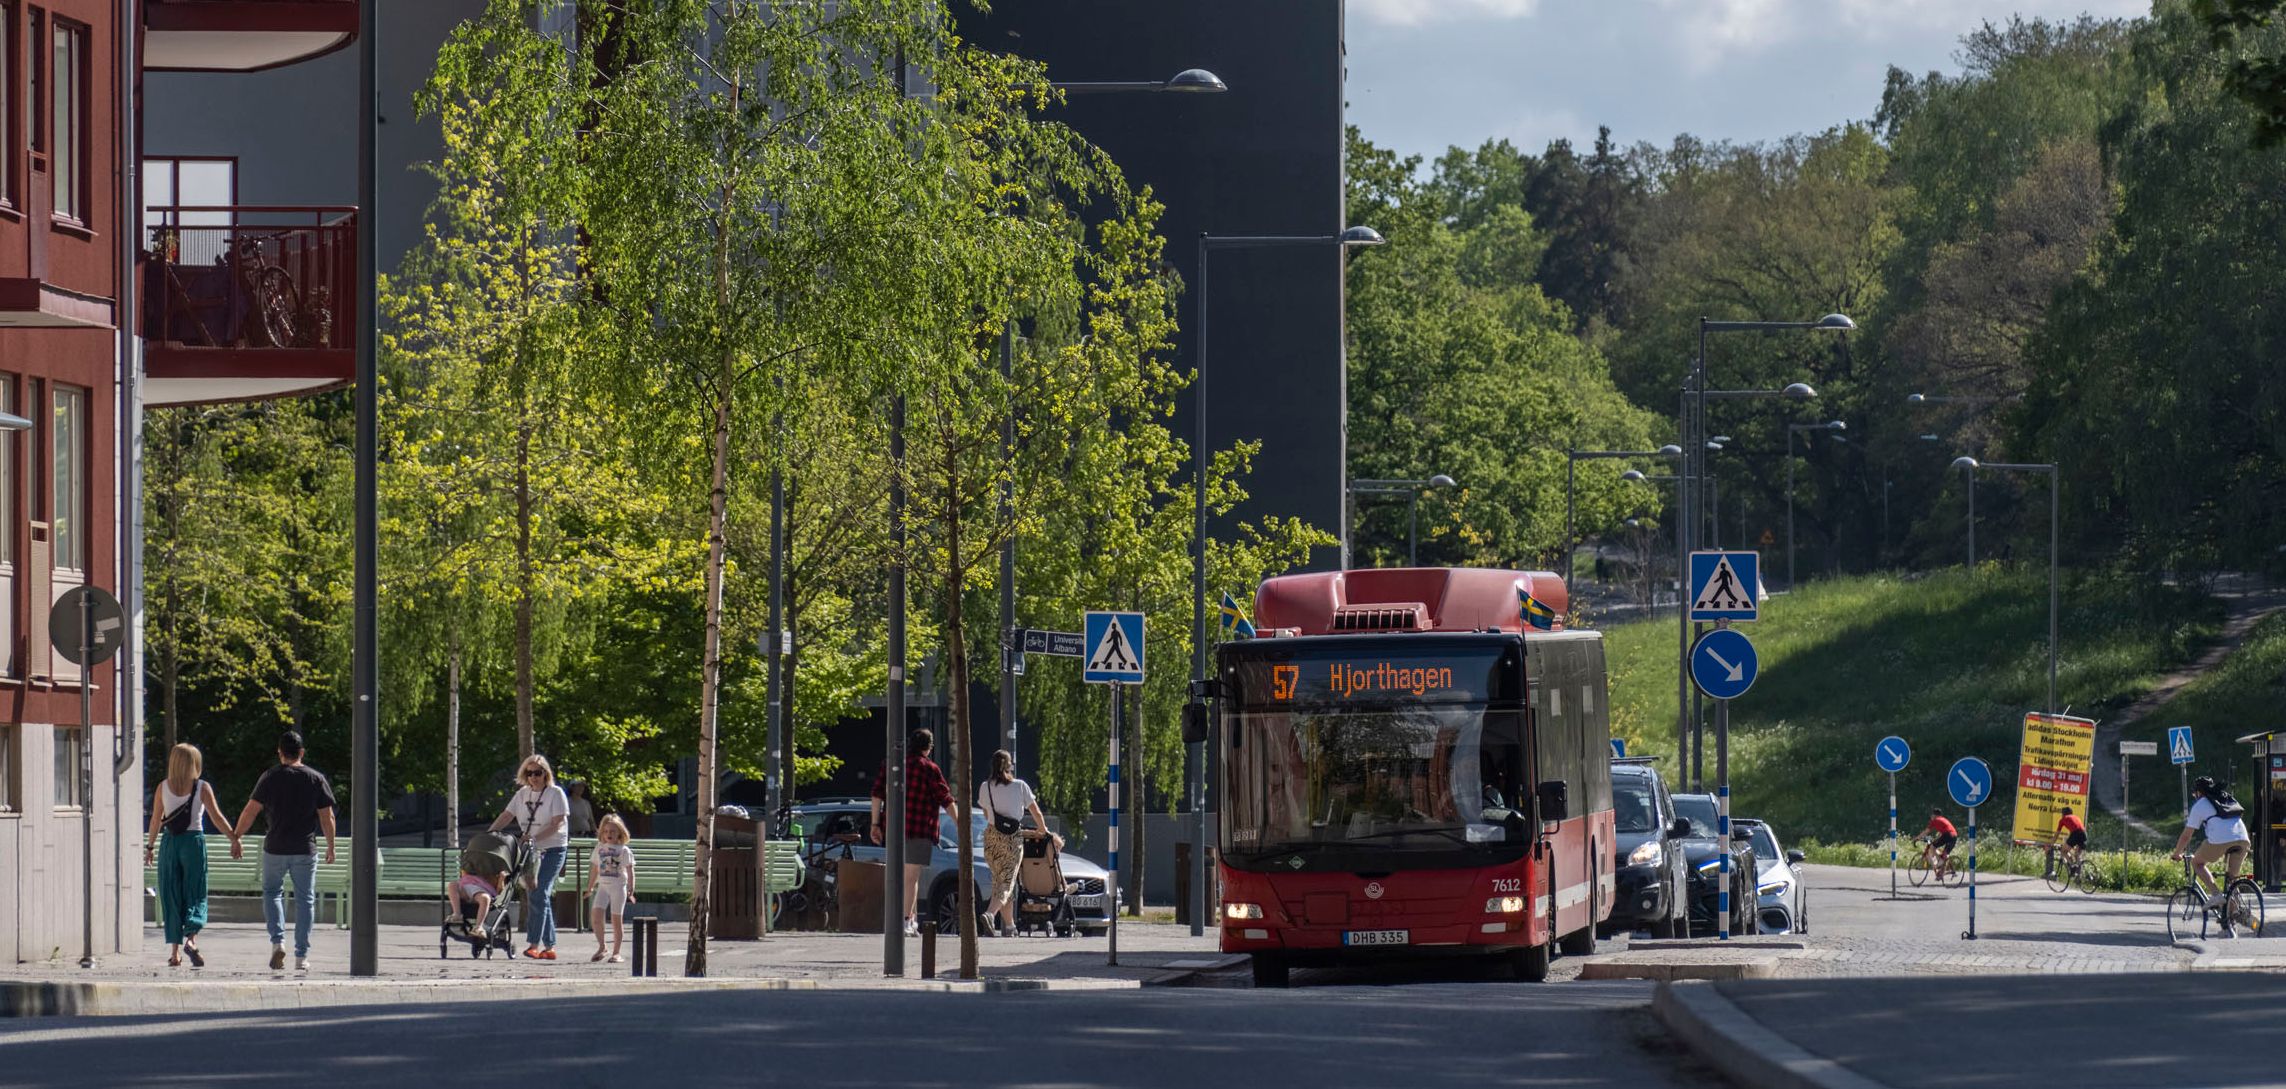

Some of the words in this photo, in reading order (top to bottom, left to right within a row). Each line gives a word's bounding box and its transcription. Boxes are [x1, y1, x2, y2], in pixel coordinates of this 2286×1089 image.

[1053, 644, 1077, 654] Albano
[1273, 665, 1299, 699] 57
[1330, 662, 1452, 698] Hjorthagen
[2027, 724, 2051, 733] adidas
[2053, 727, 2092, 739] Stockholm
[2040, 735, 2076, 747] Marathon
[2026, 777, 2034, 786] kl
[2057, 771, 2066, 780] 31
[2068, 774, 2083, 784] maj
[2022, 791, 2056, 803] Alternativ
[2057, 797, 2069, 806] väg
[2071, 798, 2082, 806] via
[2028, 803, 2048, 812] Norra
[1492, 879, 1520, 892] 7612
[1353, 932, 1376, 944] DHB
[1380, 931, 1404, 943] 335
